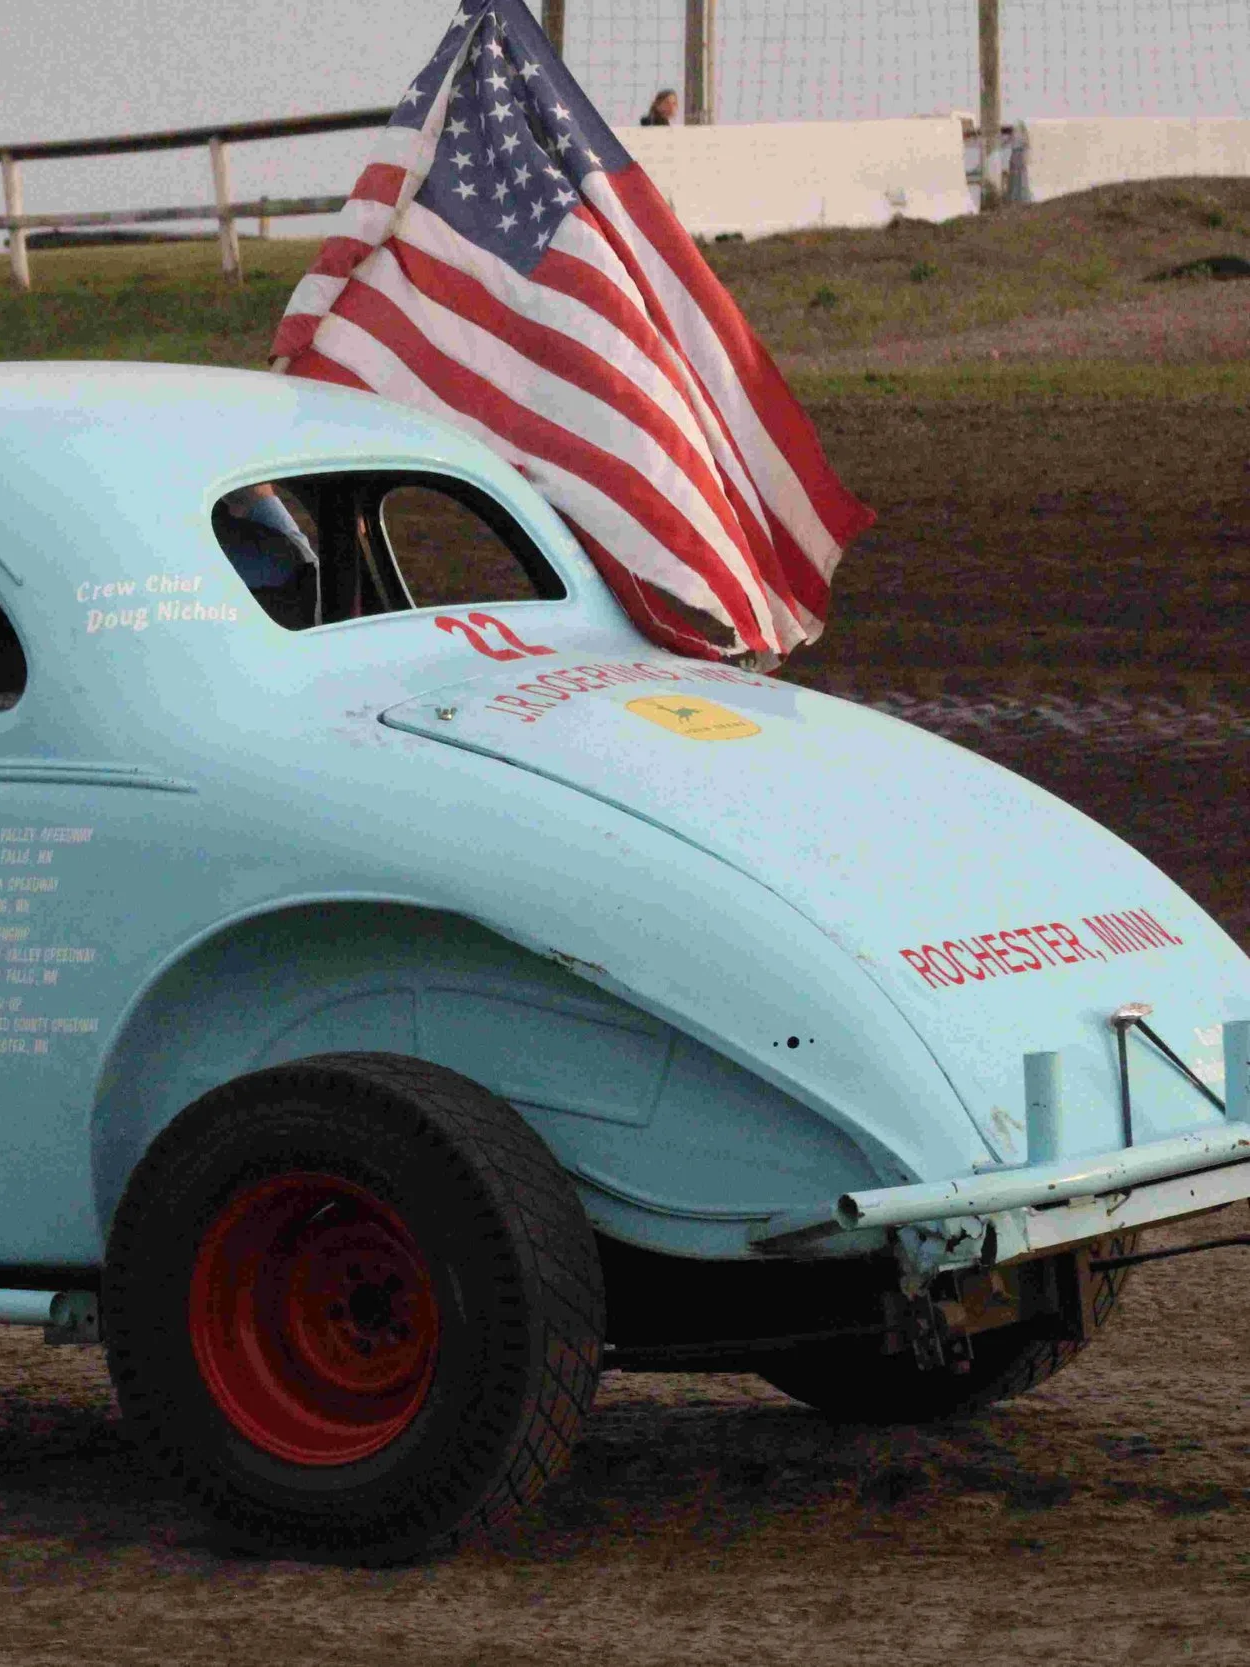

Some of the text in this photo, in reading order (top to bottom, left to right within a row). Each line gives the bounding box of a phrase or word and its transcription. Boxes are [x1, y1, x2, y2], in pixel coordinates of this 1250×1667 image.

[77, 574, 202, 602] Crew Chief
[87, 600, 238, 633] Doug Nichols
[435, 612, 558, 662] 22
[899, 908, 1183, 989] ROCHESTER, MINN.
